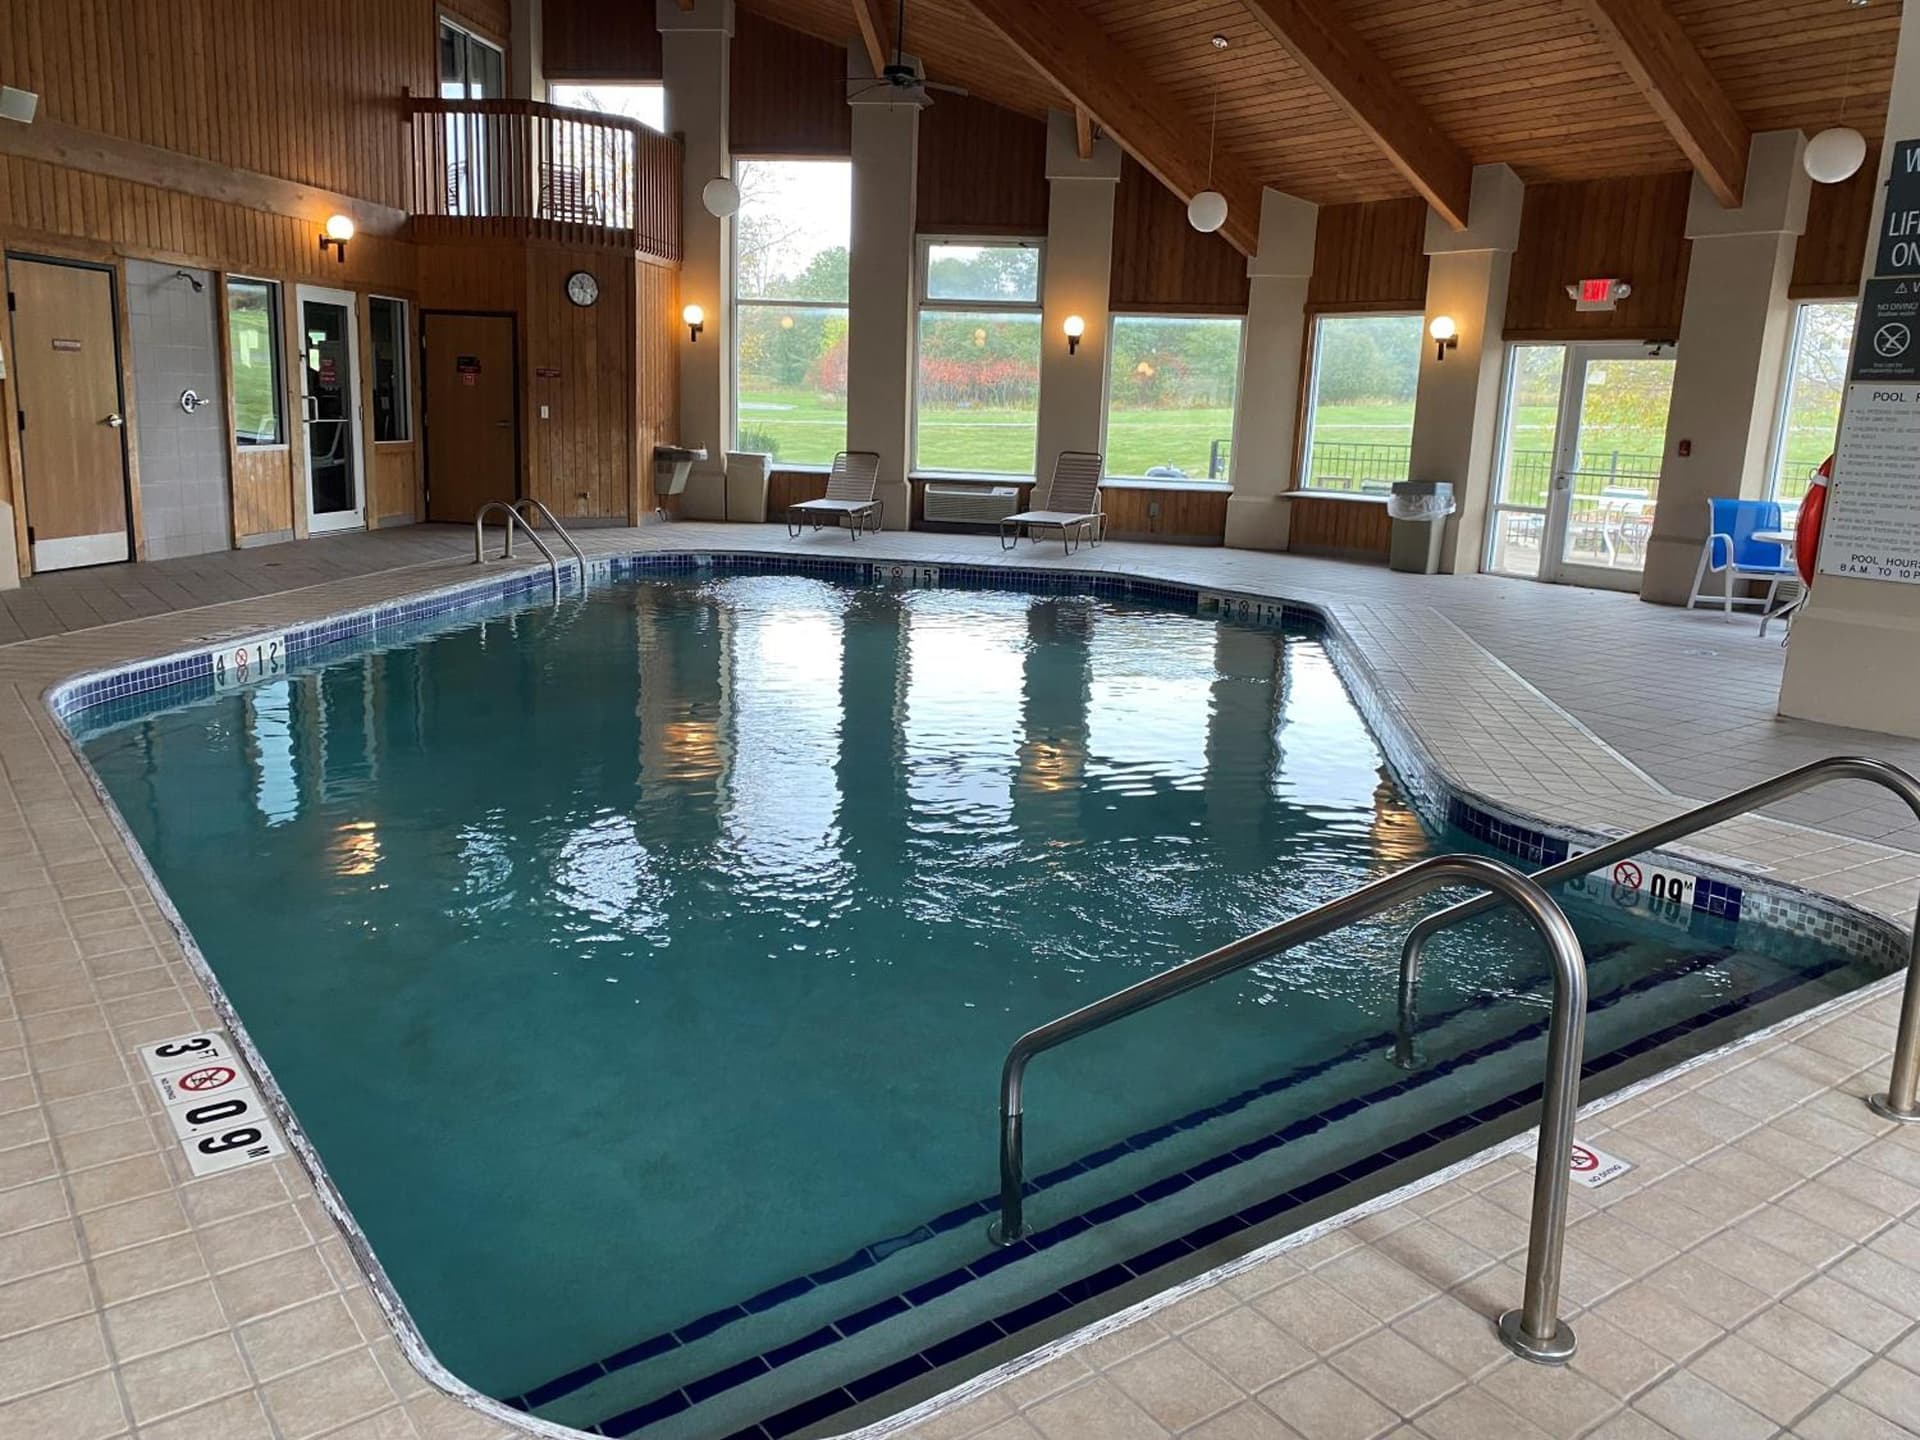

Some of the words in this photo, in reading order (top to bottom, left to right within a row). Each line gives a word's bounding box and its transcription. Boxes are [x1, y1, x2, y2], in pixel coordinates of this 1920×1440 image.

[1889, 210, 1920, 236] LIF
[1583, 280, 1610, 301] EXIT
[1872, 391, 1906, 402] POOL
[1851, 554, 1879, 565] POOL
[1878, 567, 1892, 577] TO
[1900, 570, 1911, 578] 10
